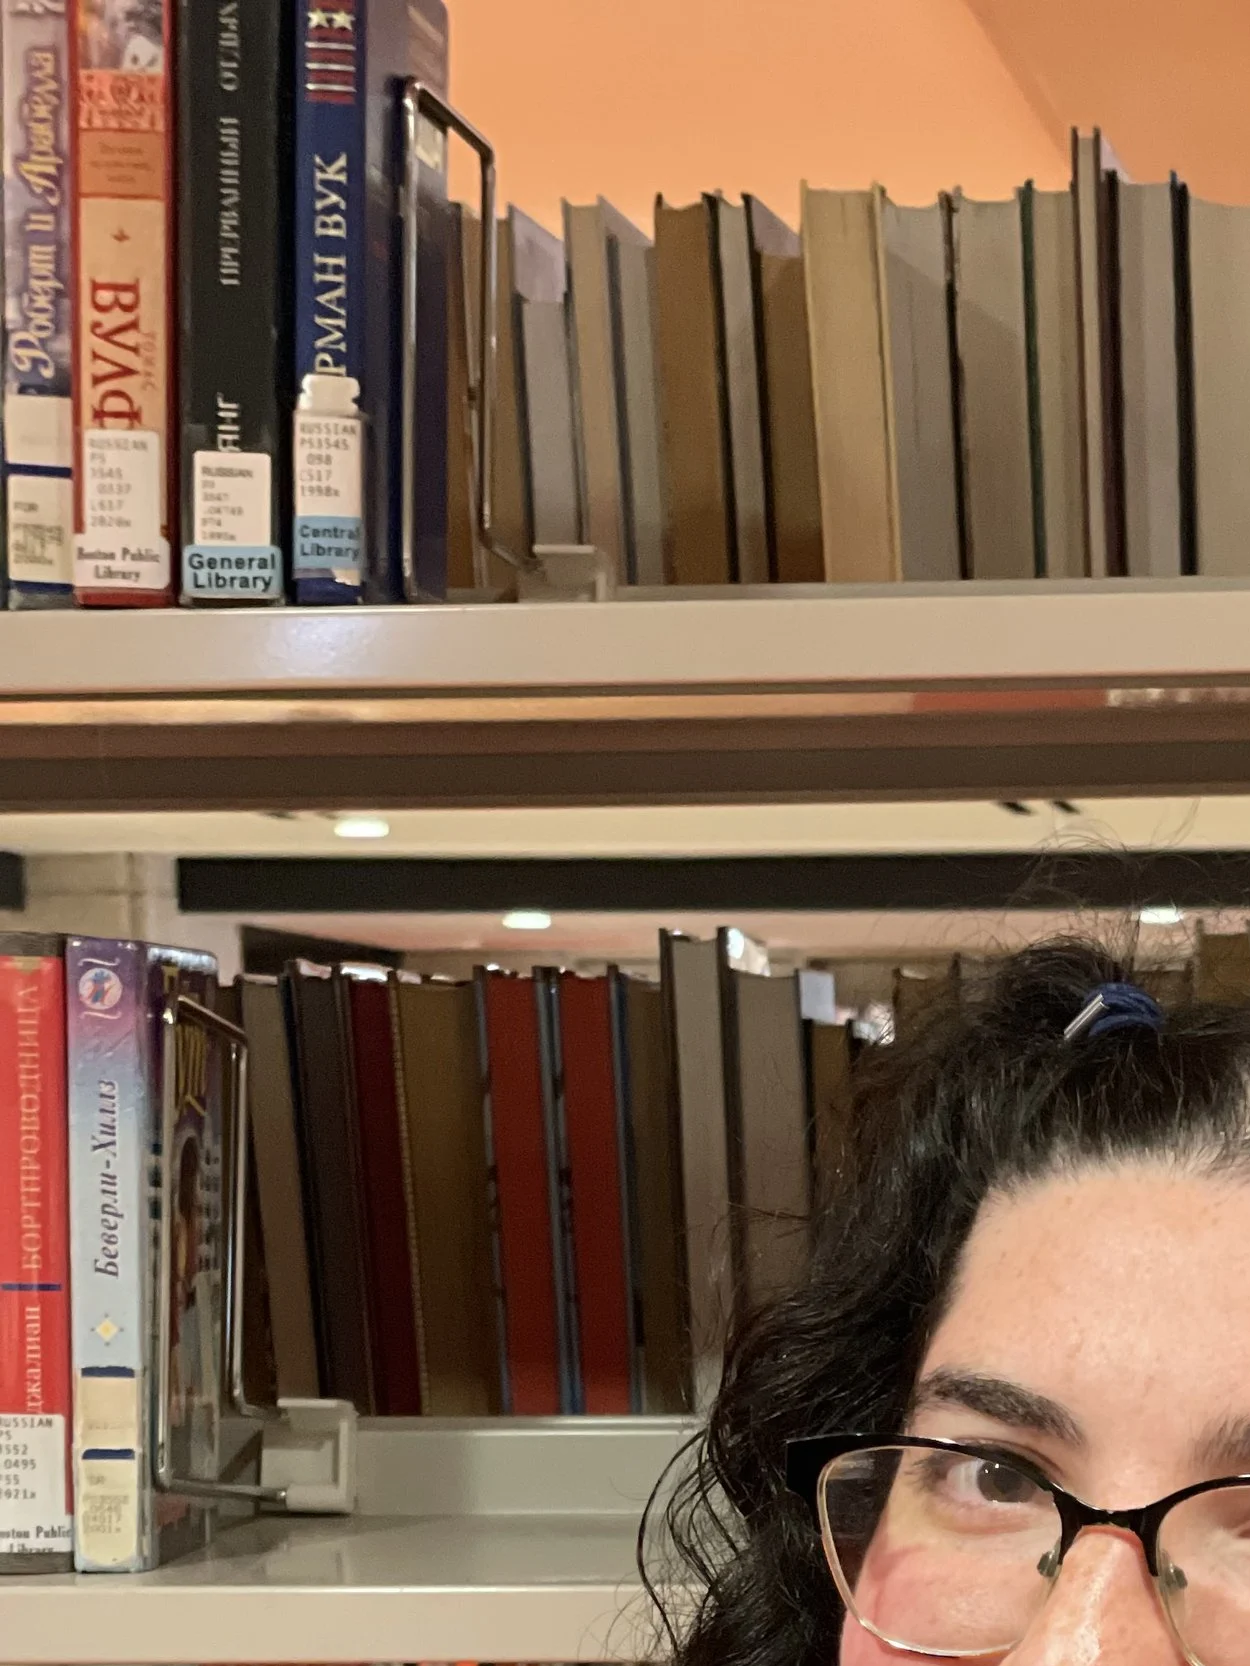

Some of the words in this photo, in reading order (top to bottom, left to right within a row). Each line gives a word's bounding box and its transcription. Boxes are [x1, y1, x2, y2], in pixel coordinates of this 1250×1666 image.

[17, 48, 65, 206] Арабелла
[313, 151, 348, 239] ВУК
[26, 213, 48, 232] и
[9, 244, 65, 378] Роберт
[299, 524, 360, 541] Central
[187, 553, 276, 571] General
[300, 543, 360, 562] Library
[93, 565, 141, 582] Library
[192, 573, 273, 593] Library
[17, 984, 44, 1272] БОРТПРОВОДНИЦА
[89, 1079, 121, 1280] Беверли-Хиллз
